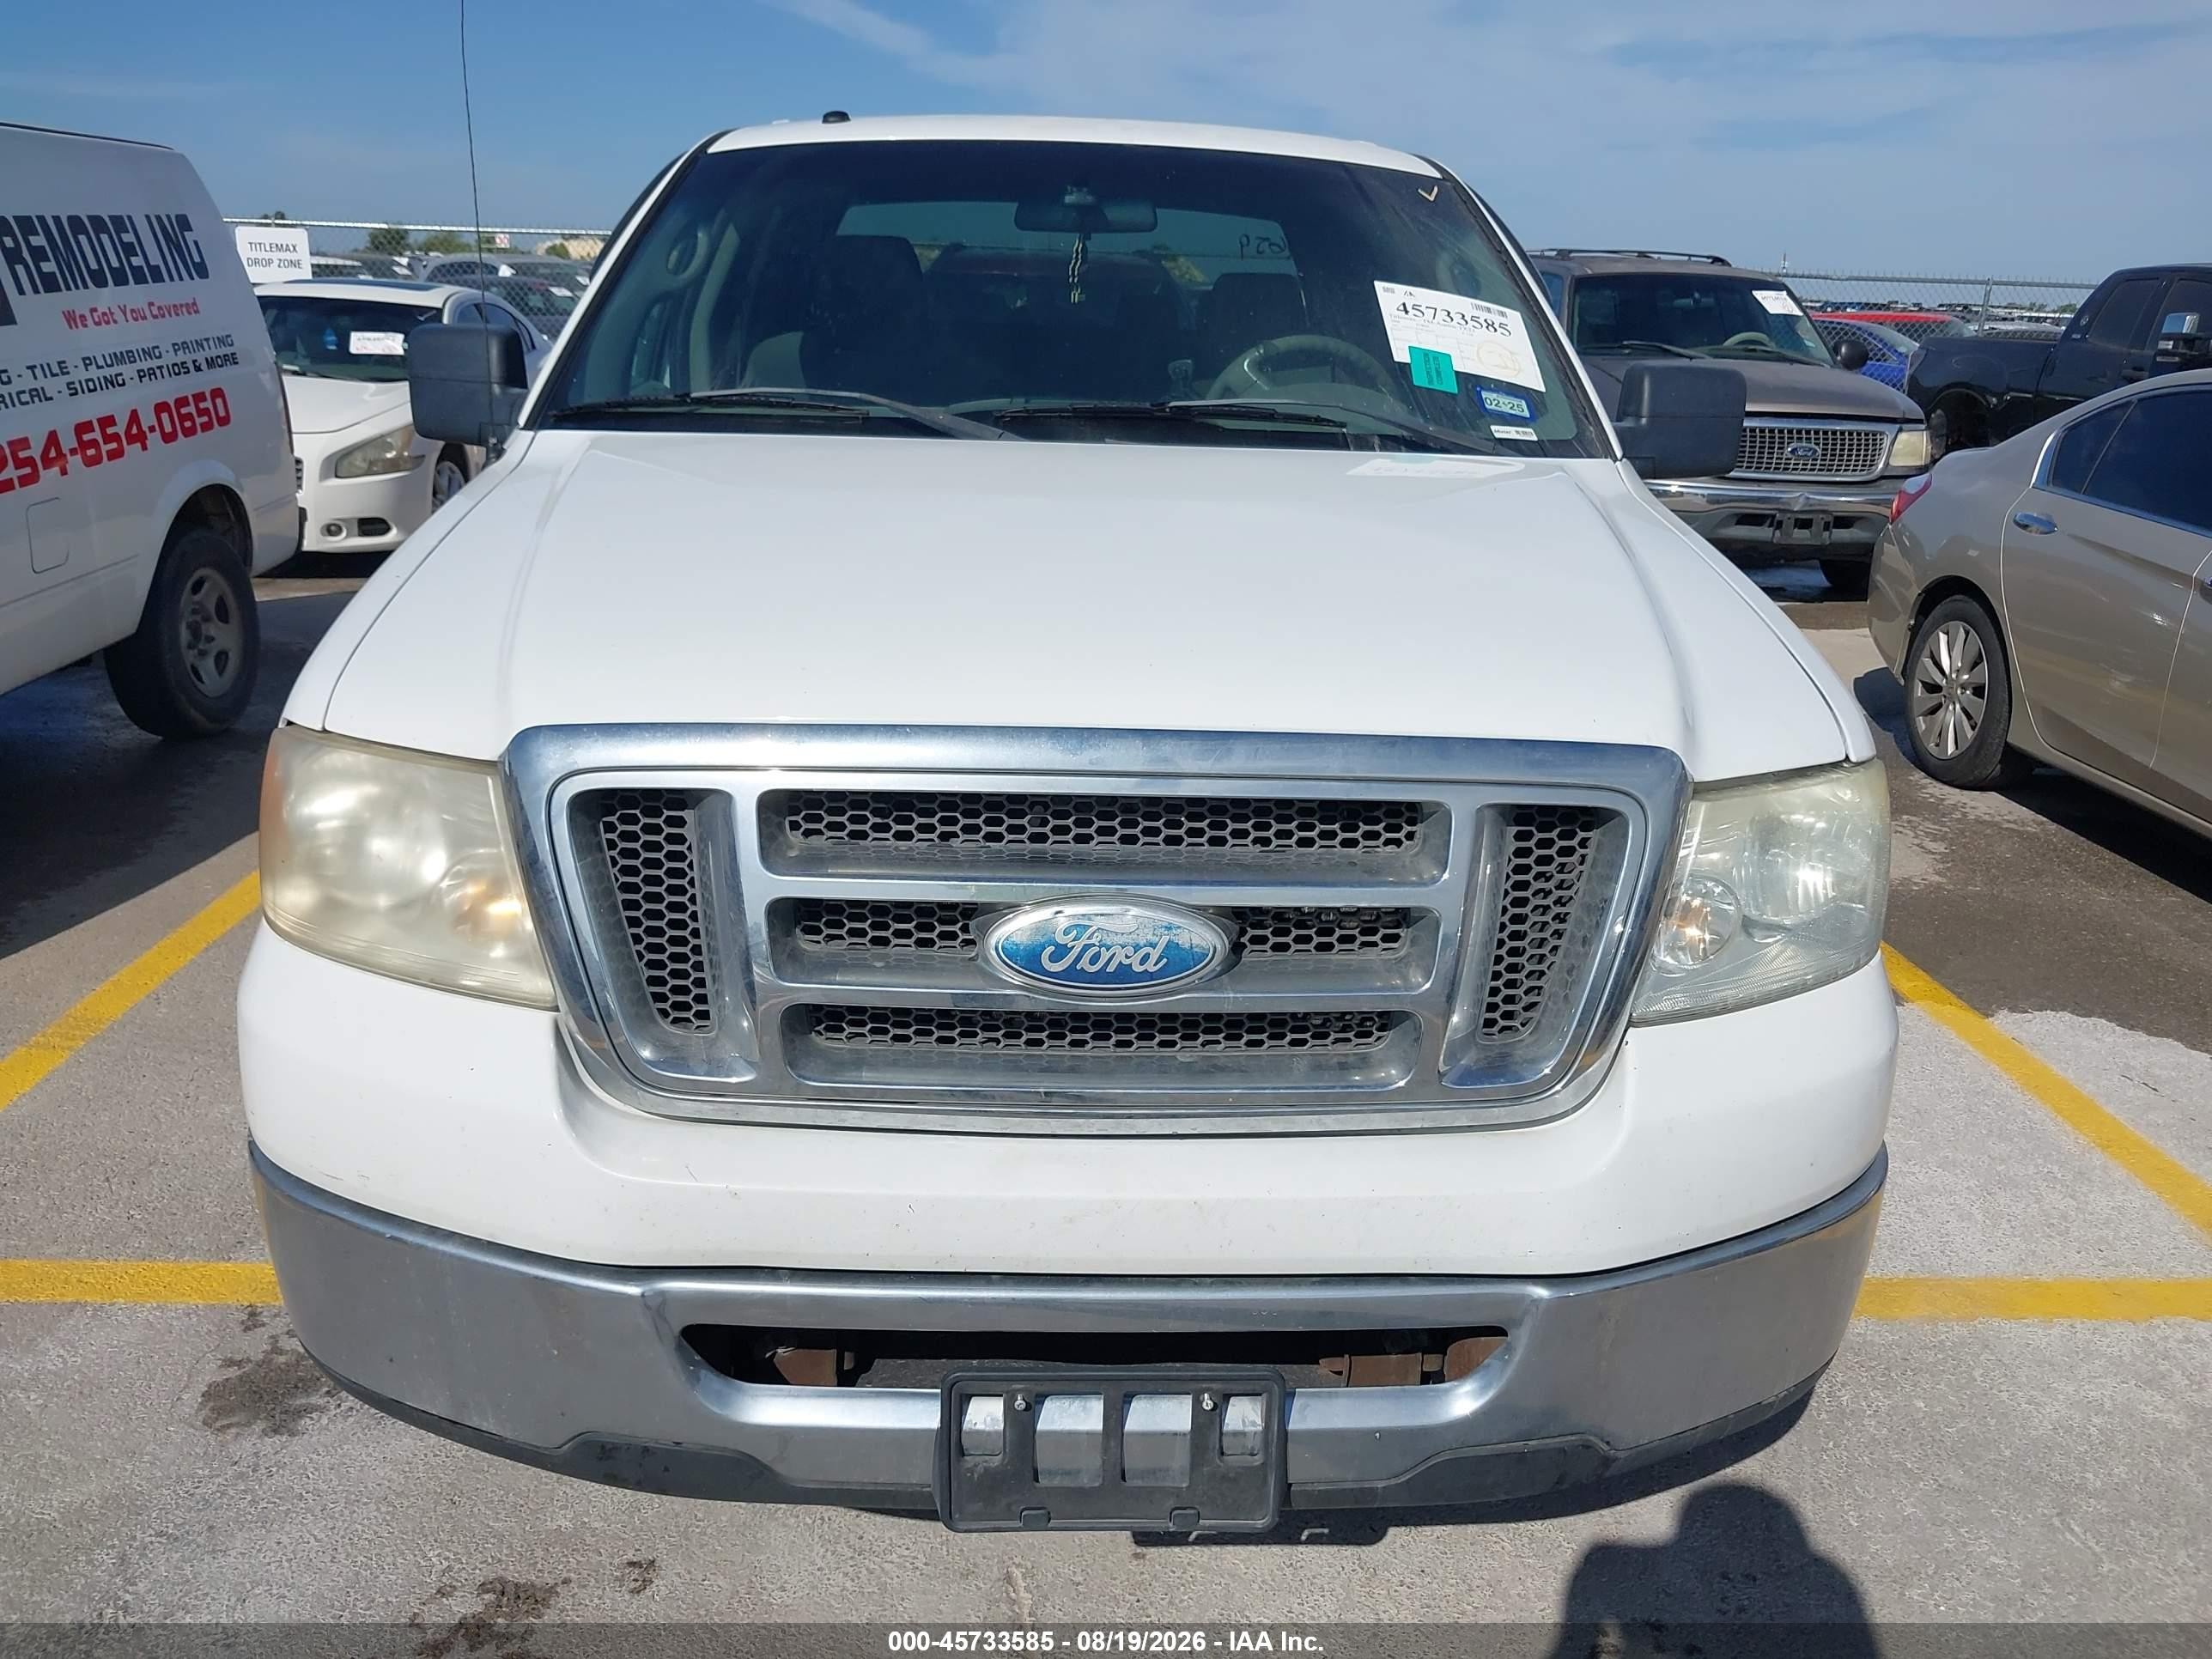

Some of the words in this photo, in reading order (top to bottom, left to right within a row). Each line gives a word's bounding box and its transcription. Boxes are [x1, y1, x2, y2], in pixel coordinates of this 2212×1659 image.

[0, 214, 210, 295] REMODELING
[246, 257, 274, 268] DROP
[276, 258, 302, 269] ZONE
[247, 241, 298, 253] TITLEMAX
[62, 308, 88, 330] We
[89, 307, 118, 326] Got
[118, 304, 148, 323] You
[148, 297, 199, 319] Covered
[1396, 301, 1512, 337] 45733585
[26, 360, 70, 380] TILE
[82, 345, 162, 372] PLUMBING
[172, 334, 234, 356] PAINTING
[66, 372, 125, 397] SIDING
[137, 361, 191, 383] PATIOS
[191, 359, 204, 373] &
[204, 352, 240, 371] MORE
[1041, 920, 1170, 973] Ford
